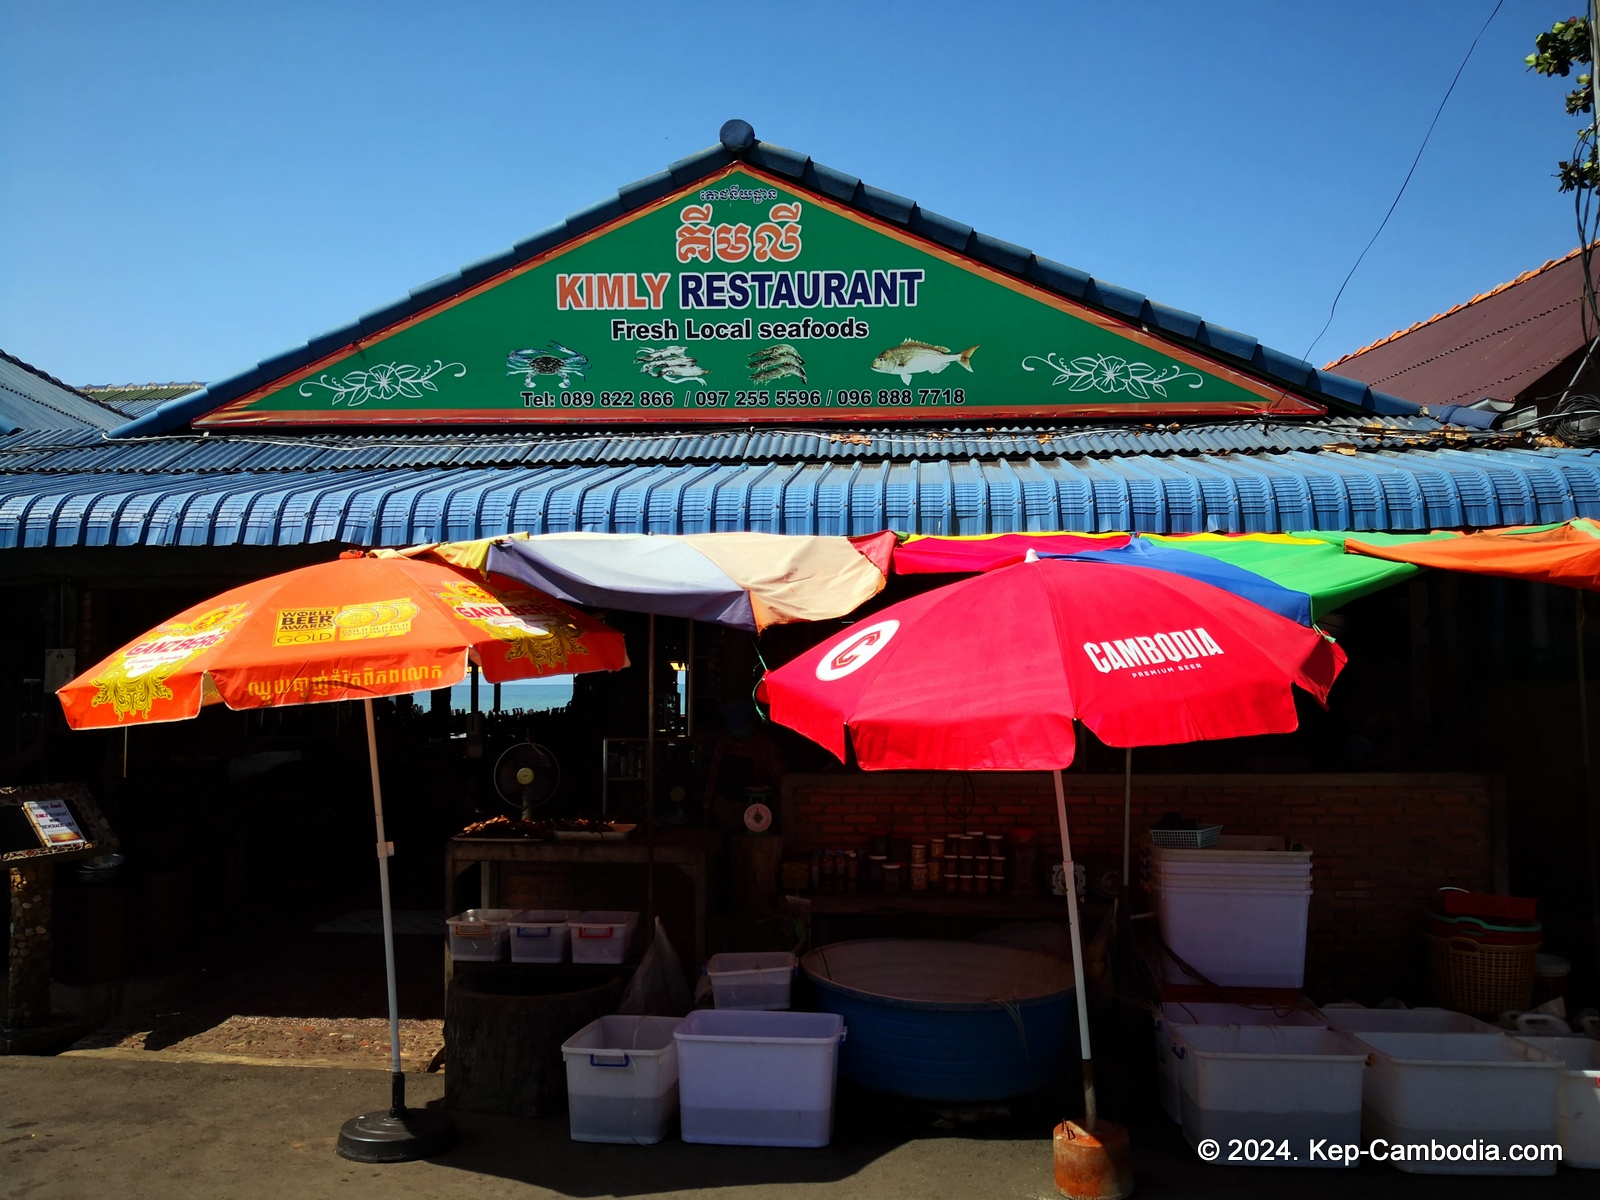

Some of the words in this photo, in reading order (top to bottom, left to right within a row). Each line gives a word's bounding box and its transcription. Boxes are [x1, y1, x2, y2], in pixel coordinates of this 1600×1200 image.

[556, 273, 671, 310] KIMLY
[679, 269, 925, 310] RESTAURANT
[611, 318, 679, 340] Fresh
[685, 318, 752, 340] Local
[758, 317, 869, 340] seafoods
[521, 391, 555, 407] Tel:
[560, 391, 595, 407] 089
[600, 391, 634, 407] 822
[639, 391, 674, 407] 866
[695, 391, 729, 407] 097
[734, 390, 769, 407] 255
[775, 390, 821, 406] 5596
[837, 389, 872, 406] 096
[877, 389, 912, 405] 888
[918, 388, 965, 405] 7718
[282, 610, 335, 618] WORLD
[456, 602, 562, 619] GANZBERG
[280, 623, 334, 632] AWARDS
[281, 615, 333, 626] BEER
[125, 631, 228, 656] GANZBERG
[276, 632, 332, 644] GOLD
[1083, 627, 1225, 674] CAMBODIA
[1132, 667, 1175, 678] PREMIUM
[1178, 663, 1203, 673] BEER
